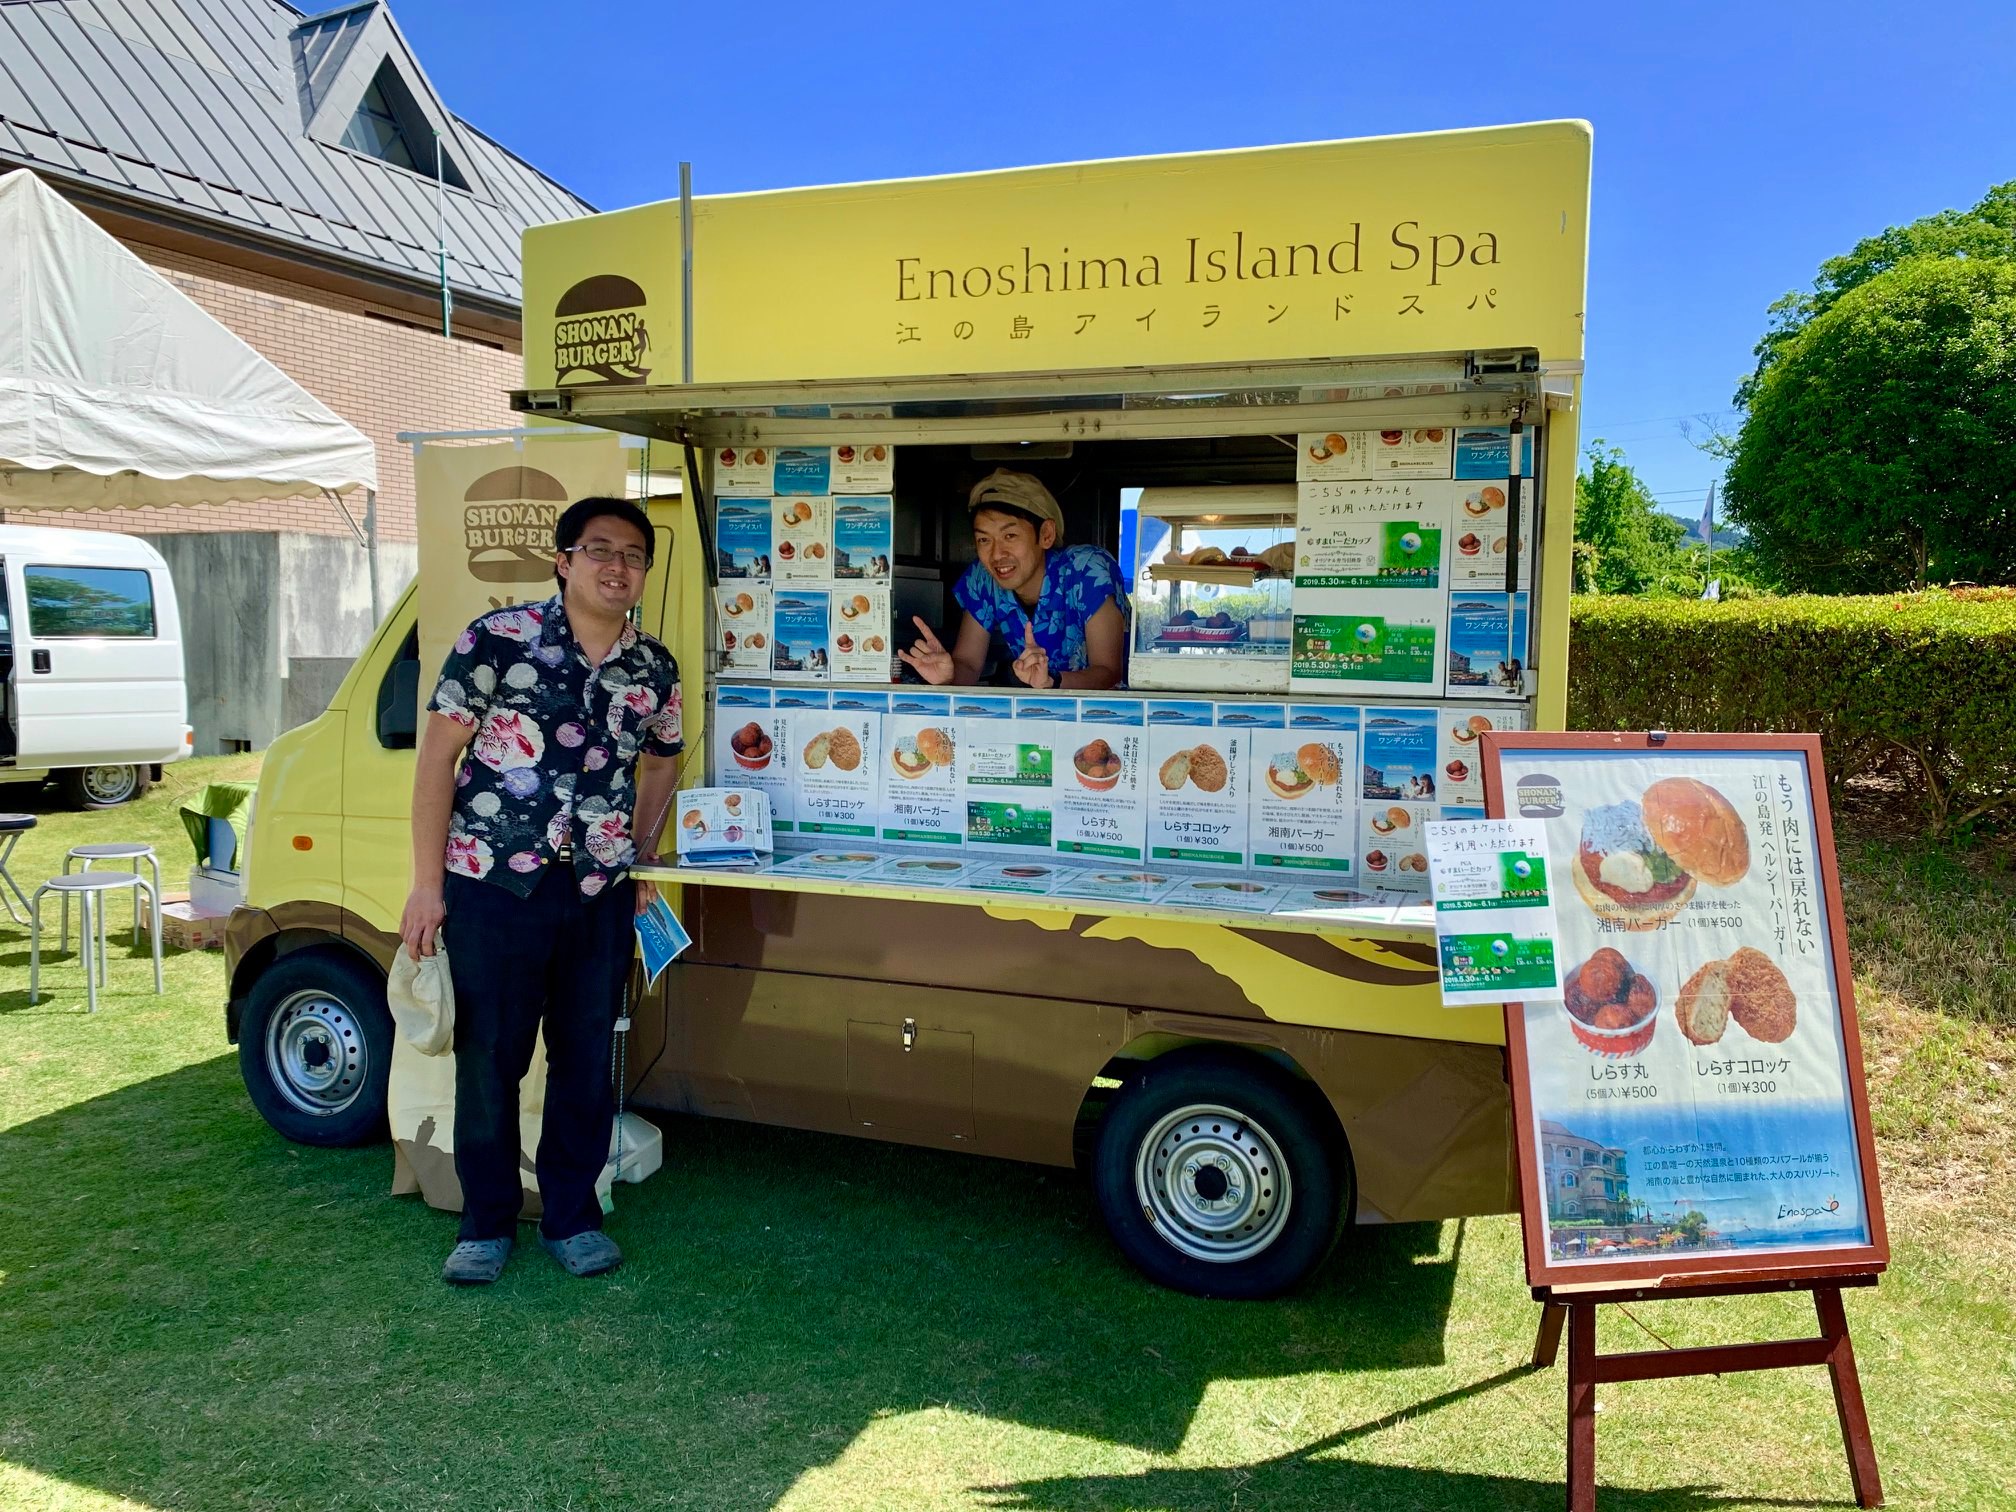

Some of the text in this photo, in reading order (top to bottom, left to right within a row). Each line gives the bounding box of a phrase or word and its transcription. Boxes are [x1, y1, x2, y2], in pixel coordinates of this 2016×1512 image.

[895, 221, 1501, 302] Enoshima Island Spa
[895, 288, 1498, 344] 江の島アイランドスパ
[556, 313, 635, 346] SHONAN
[556, 341, 635, 370] BURGER
[1471, 450, 1510, 460] ワンデイス
[1309, 486, 1412, 498] こちらのチケットも
[1319, 501, 1424, 515] ご利用いただけます
[466, 505, 556, 527] SHONAN
[466, 528, 556, 549] BURGER
[1518, 788, 1556, 797] SHONAN
[807, 798, 865, 810] しらすコロッケ
[1519, 796, 1557, 805] BURGER
[893, 803, 950, 816] 湘南バーガー
[1081, 815, 1119, 829] しらす丸
[1164, 820, 1232, 834] しらすコロッケ
[1268, 826, 1335, 840] 湘南バーガー
[1431, 823, 1514, 836] こちらのチケットも
[1442, 838, 1536, 852] ご利用いただけます
[1778, 774, 1815, 954] もう肉には戻れない
[1596, 916, 1682, 933] 湘南バーガー
[1590, 1062, 1649, 1081] しらす丸
[1696, 1058, 1792, 1076] しらすコロッケ
[1777, 1202, 1838, 1222] Enospa
